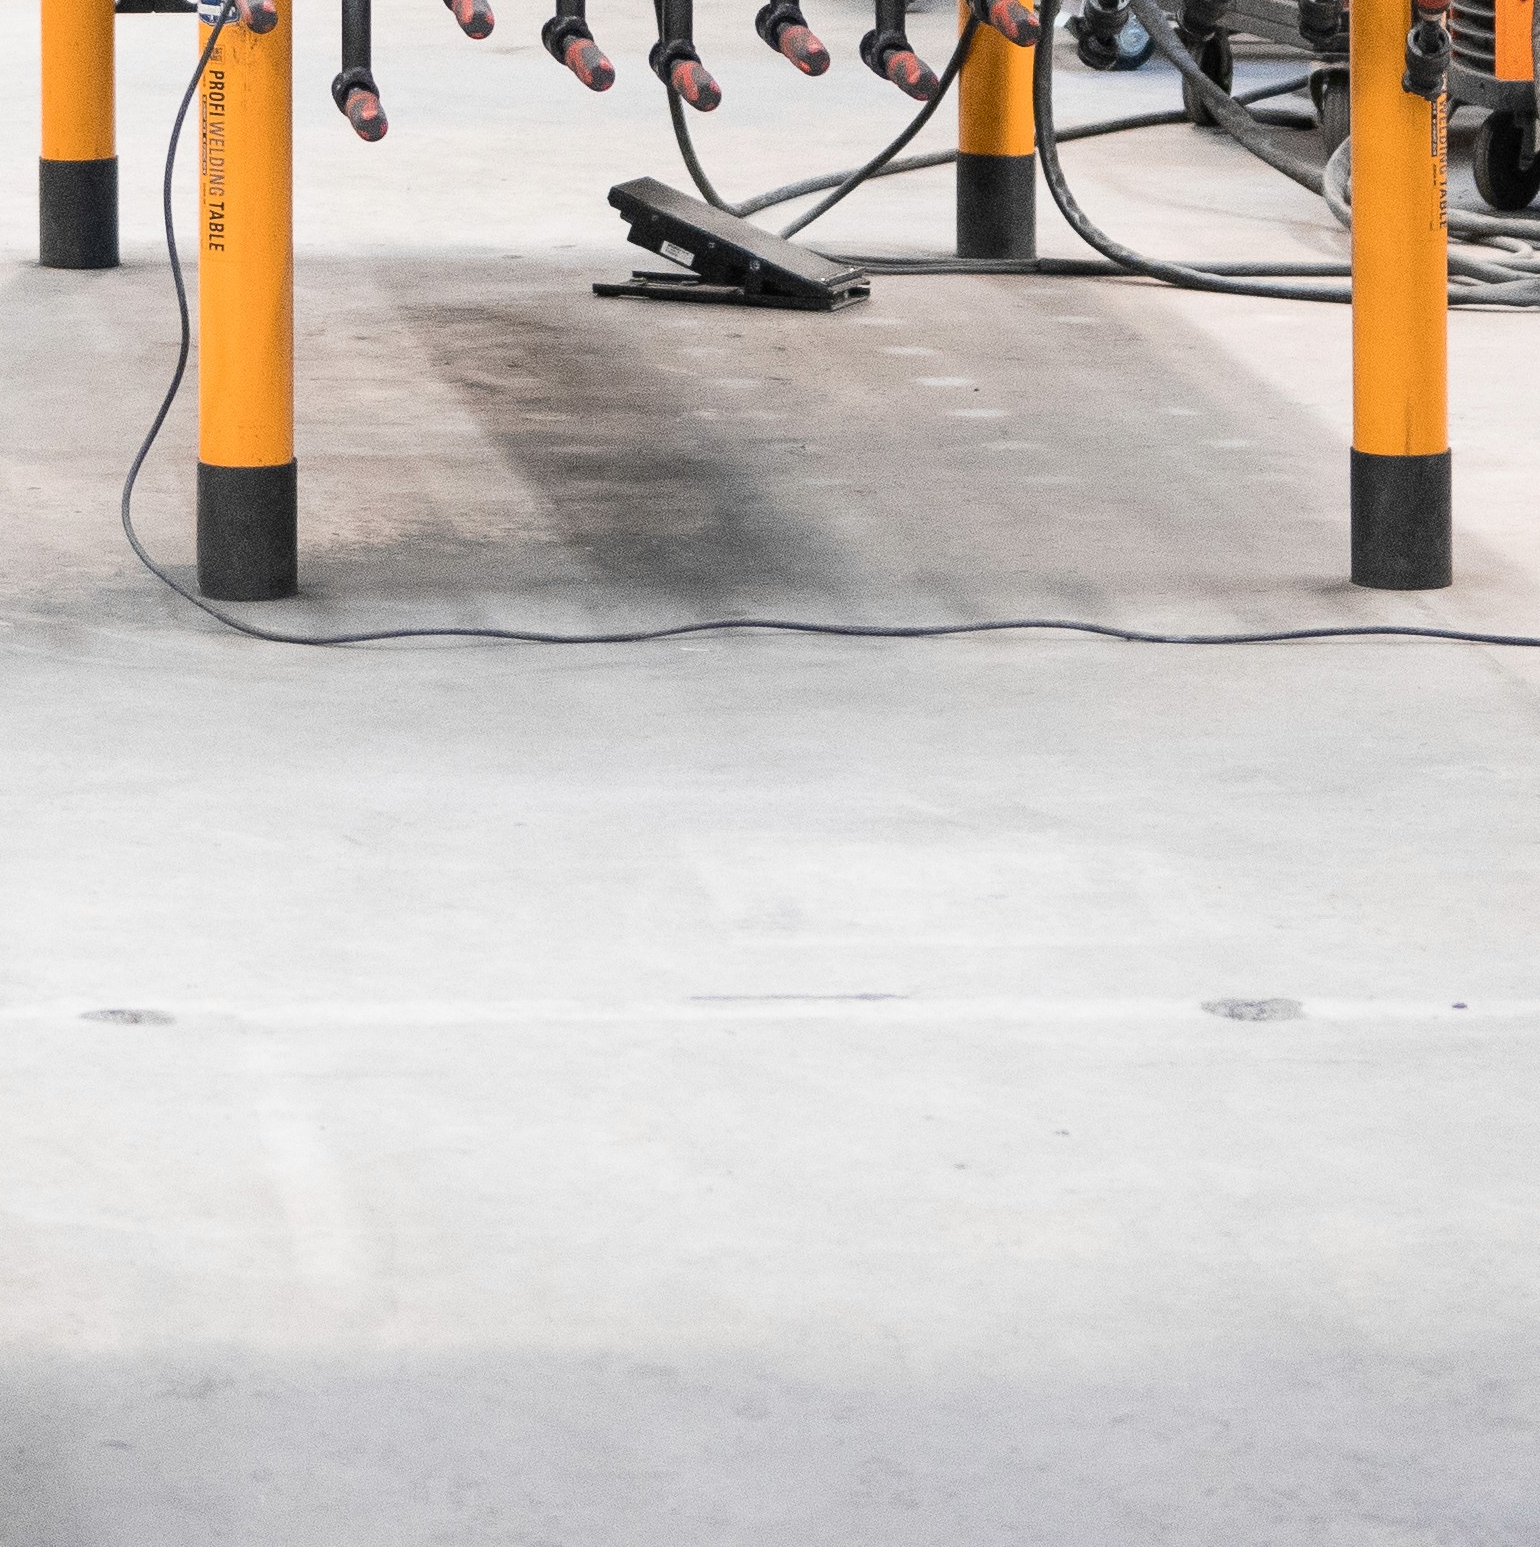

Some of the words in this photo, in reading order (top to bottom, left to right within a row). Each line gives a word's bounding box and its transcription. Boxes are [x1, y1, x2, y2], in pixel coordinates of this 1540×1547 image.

[209, 70, 225, 114] PROFI
[208, 118, 224, 197] WELDING
[208, 201, 224, 251] TABLE
